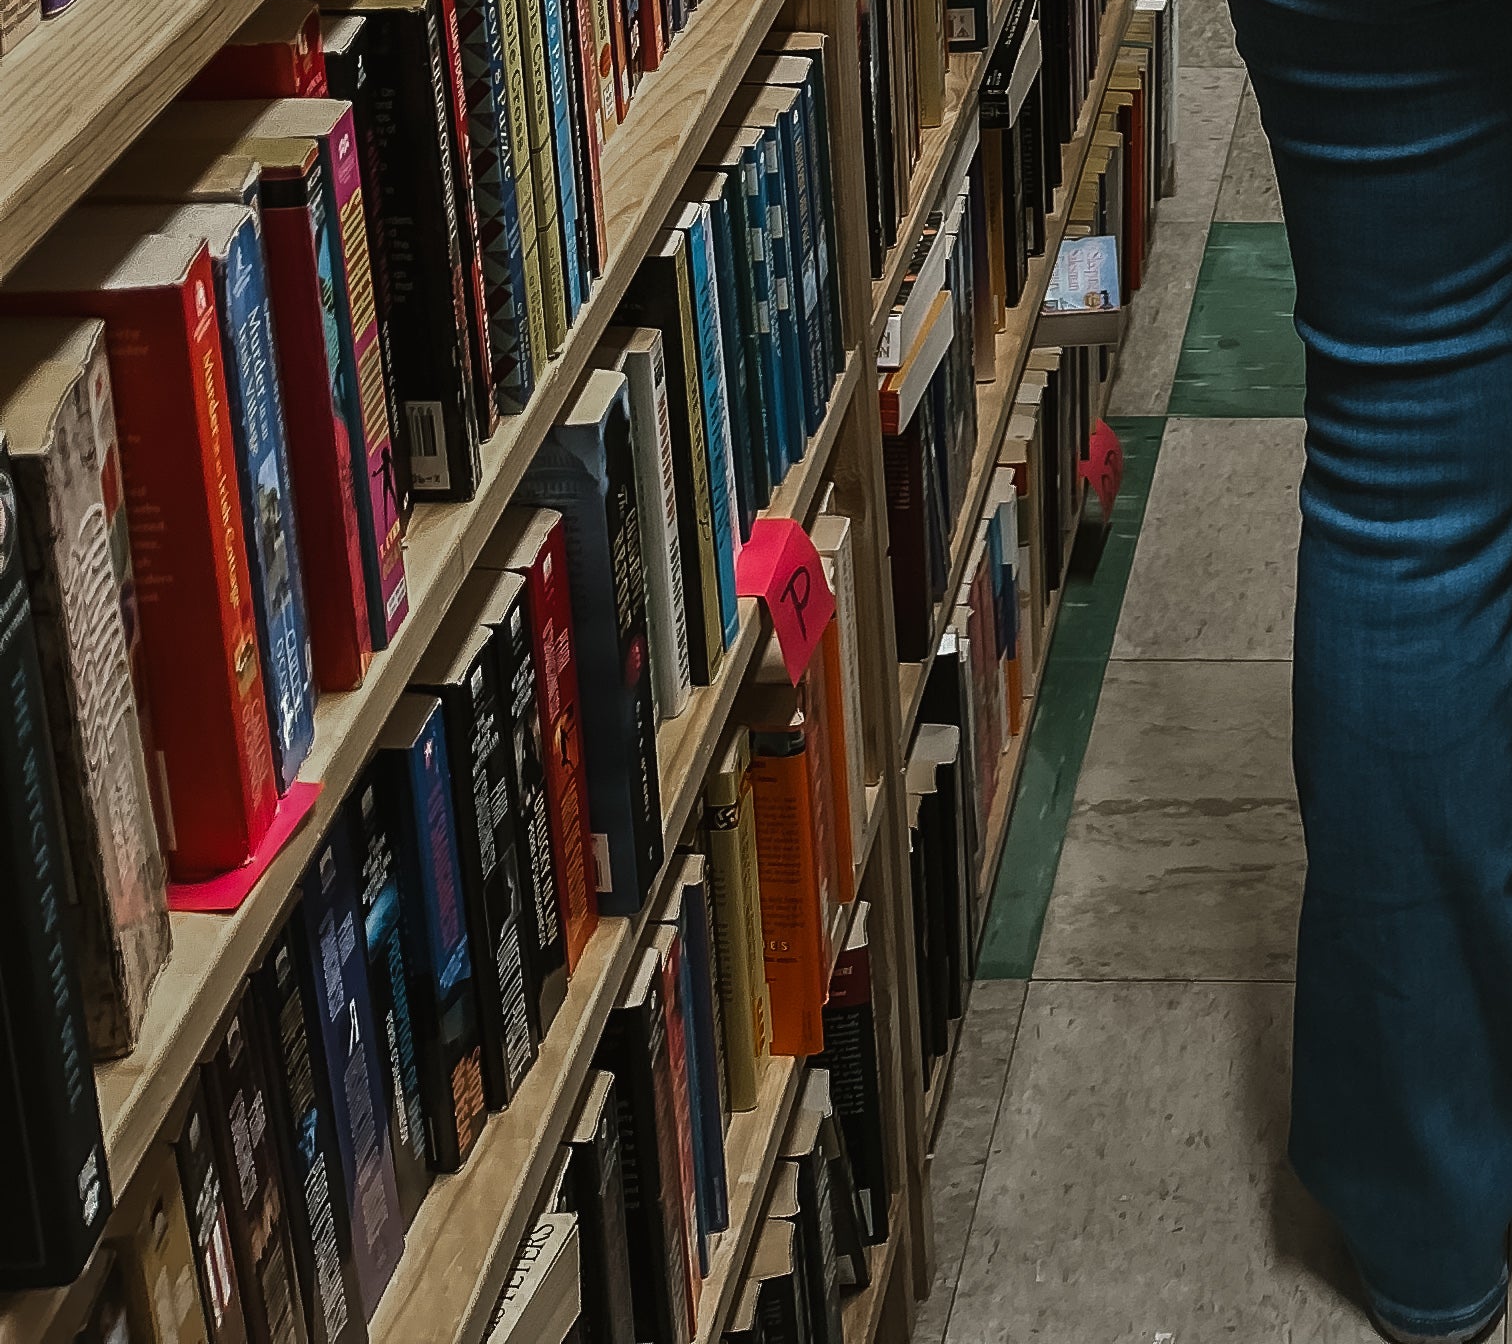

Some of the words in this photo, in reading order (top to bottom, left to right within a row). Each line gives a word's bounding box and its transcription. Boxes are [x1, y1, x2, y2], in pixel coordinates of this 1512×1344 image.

[202, 348, 225, 439] Murder
[214, 474, 234, 529] Irish
[222, 535, 243, 612] Cottage
